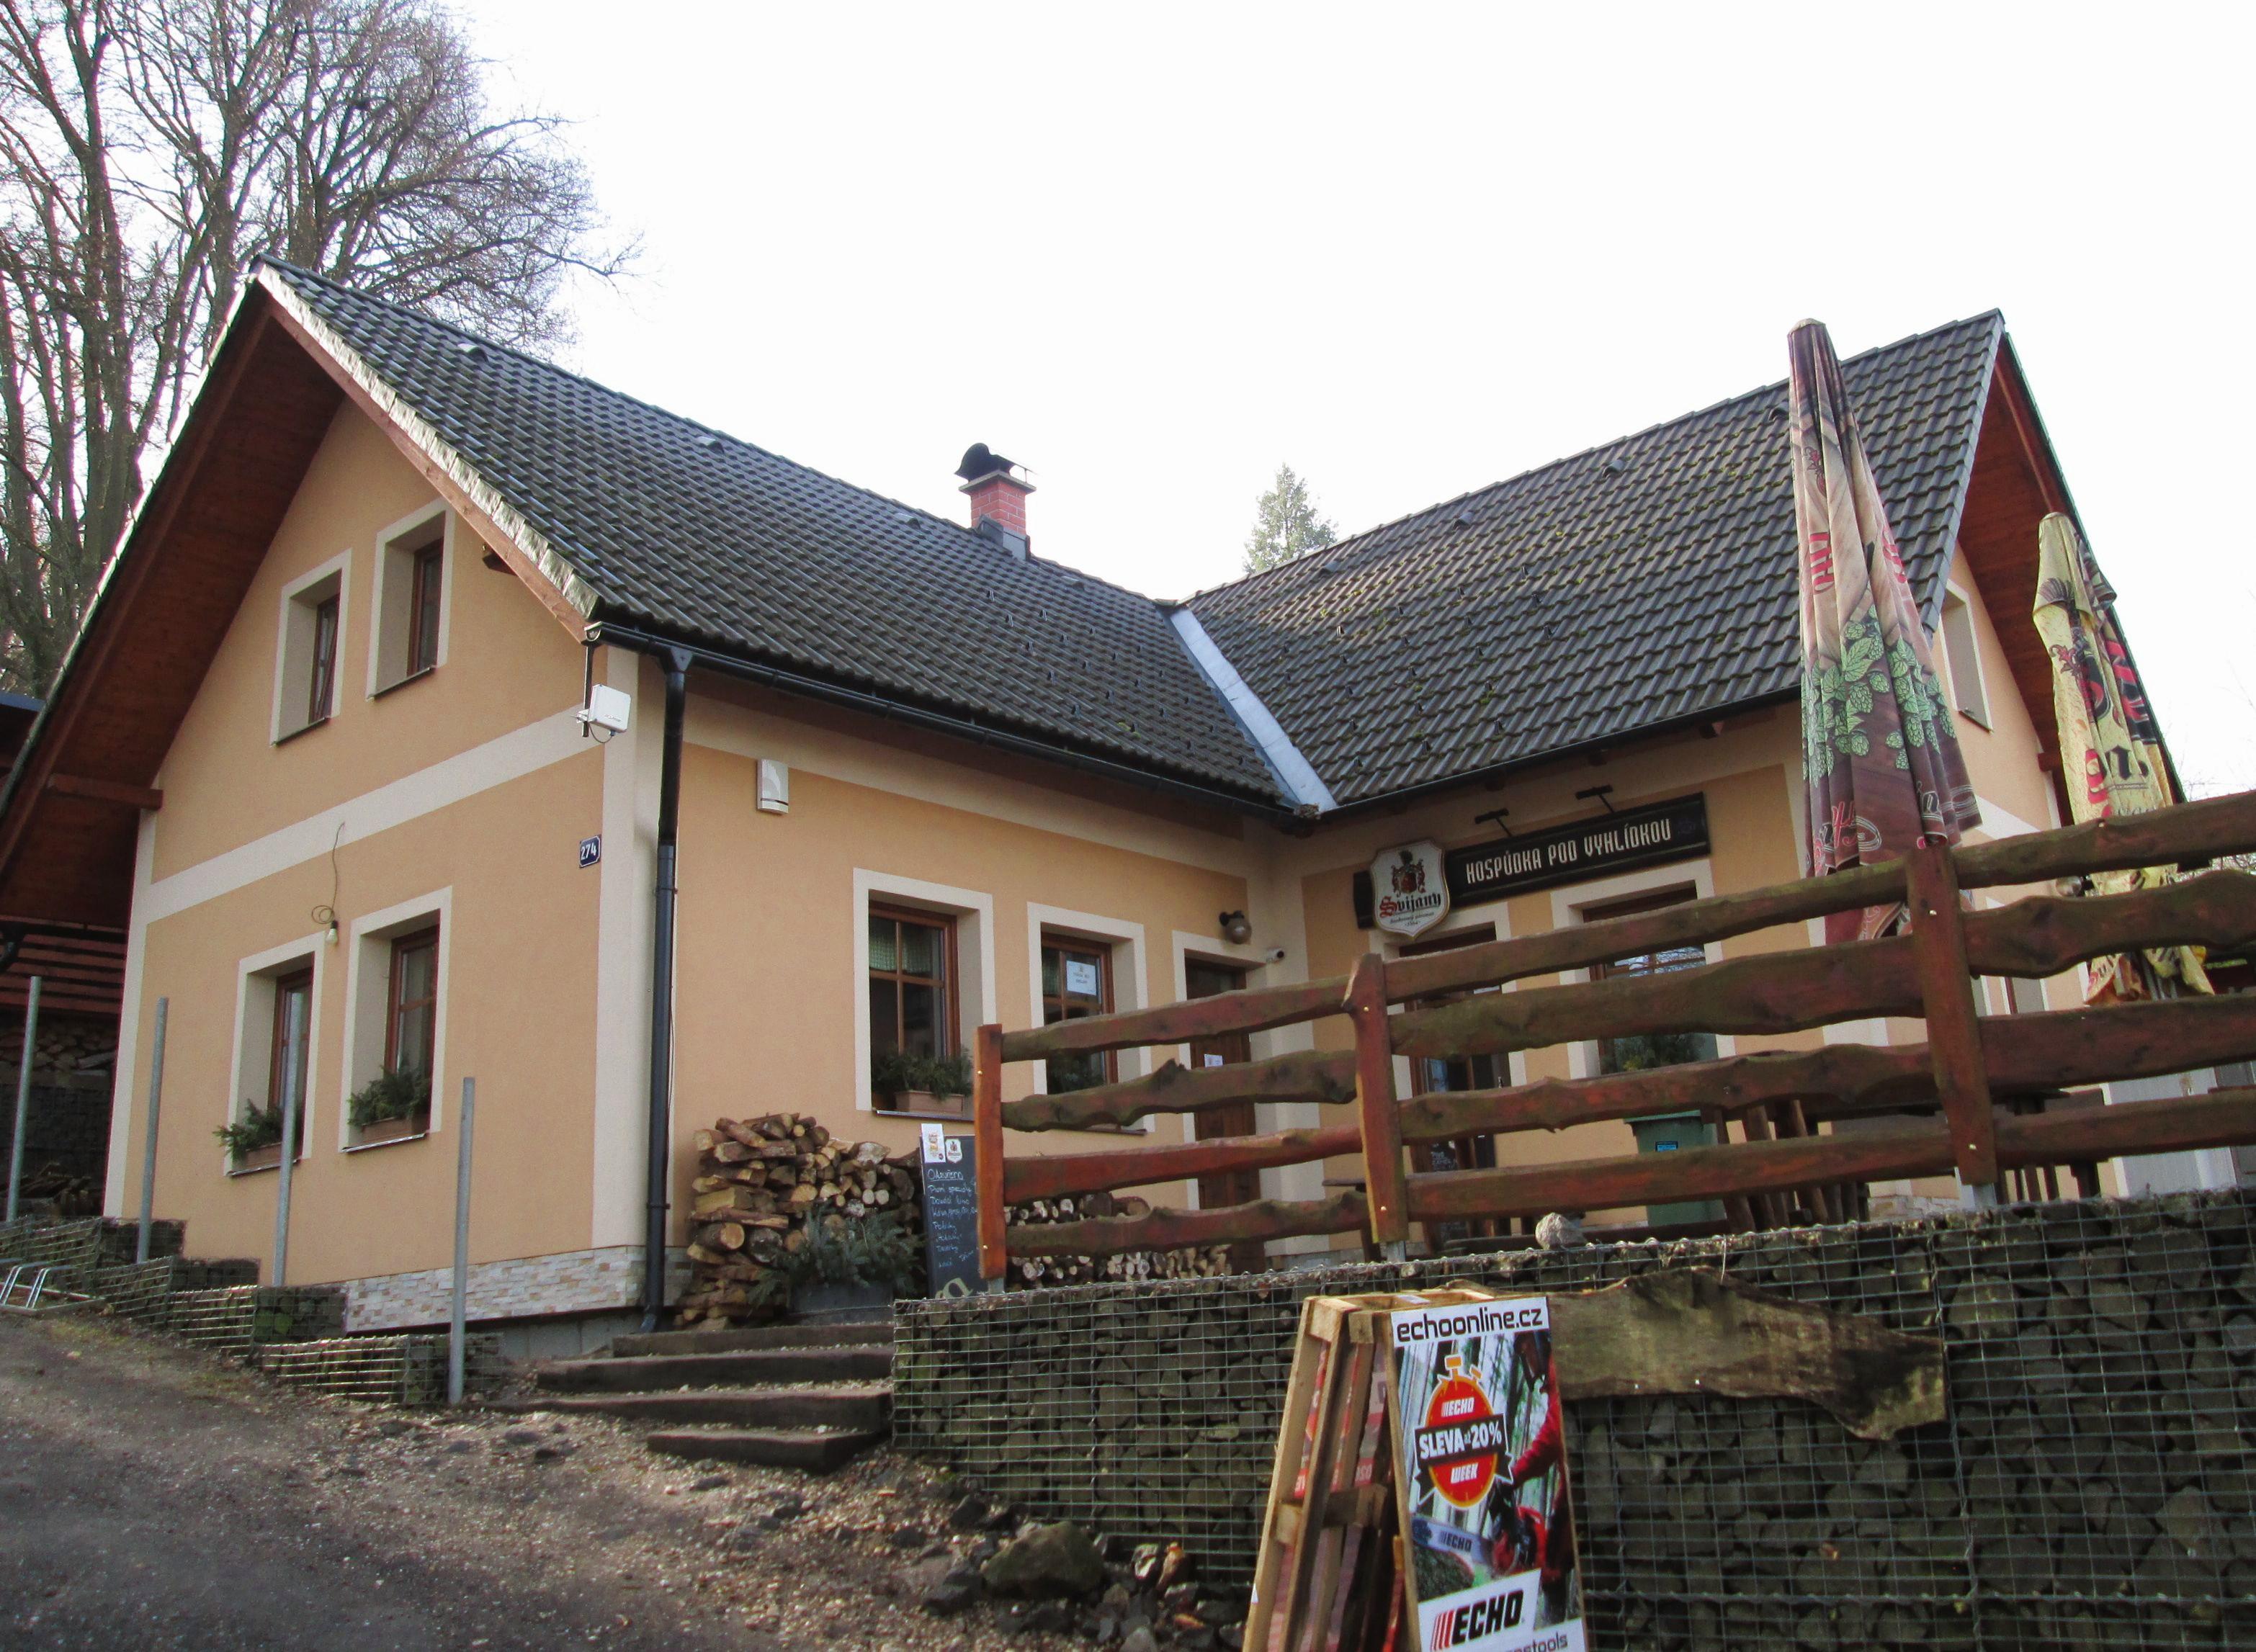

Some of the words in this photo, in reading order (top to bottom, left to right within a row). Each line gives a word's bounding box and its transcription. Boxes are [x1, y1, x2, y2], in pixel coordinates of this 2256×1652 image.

[581, 843, 597, 860] 274
[1466, 848, 1541, 884] HOSPŮDKA
[1548, 840, 1578, 866] POD
[1584, 818, 1672, 858] VYHLÍDKOU
[1379, 892, 1441, 919] Svijany
[1396, 1306, 1543, 1343] echoonline.cz
[1447, 1396, 1475, 1417] ECHO
[1418, 1427, 1465, 1460] SLEVA
[1470, 1419, 1503, 1450] 20%
[1450, 1463, 1479, 1484] WEEK
[1446, 1532, 1472, 1553] ECHO
[1451, 1588, 1524, 1645] ECHO
